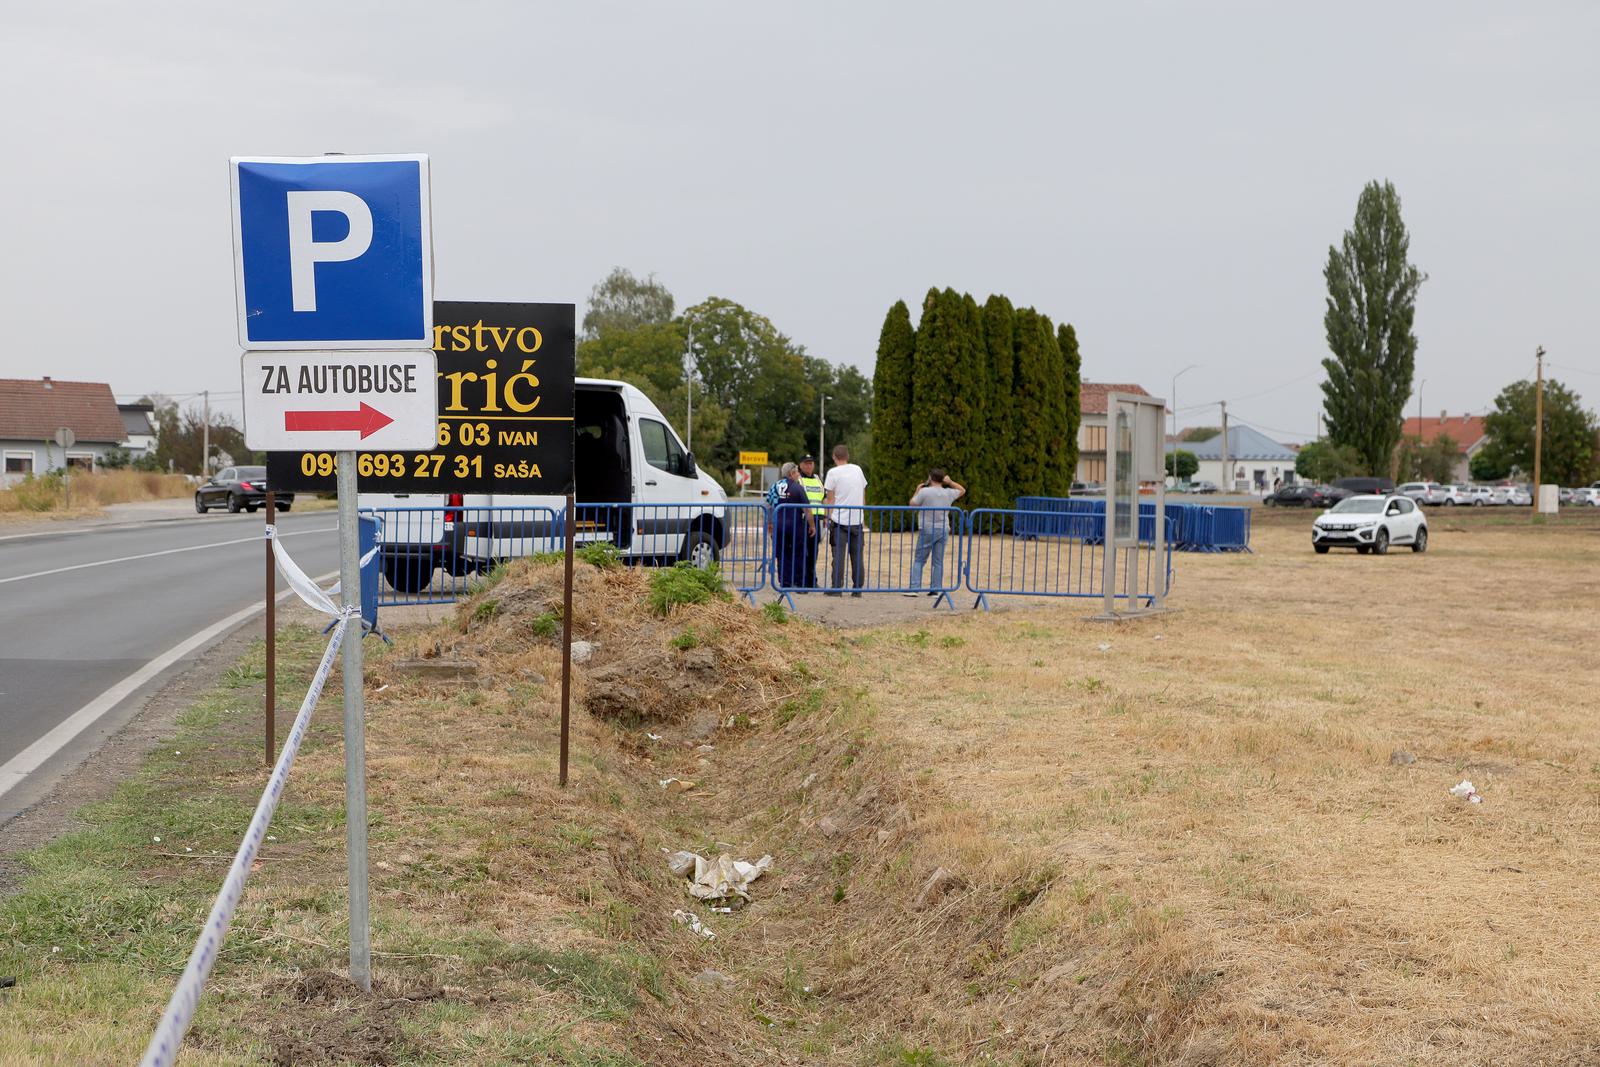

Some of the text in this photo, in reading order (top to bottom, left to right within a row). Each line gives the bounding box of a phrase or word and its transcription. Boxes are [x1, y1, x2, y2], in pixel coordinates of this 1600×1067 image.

[286, 190, 374, 312] P
[261, 364, 417, 394] ZA AUTOBUSE
[437, 358, 541, 413] rić
[459, 422, 490, 446] 03
[498, 431, 538, 446] IVAN
[301, 452, 542, 479] 09 693 27 31 SAŠA
